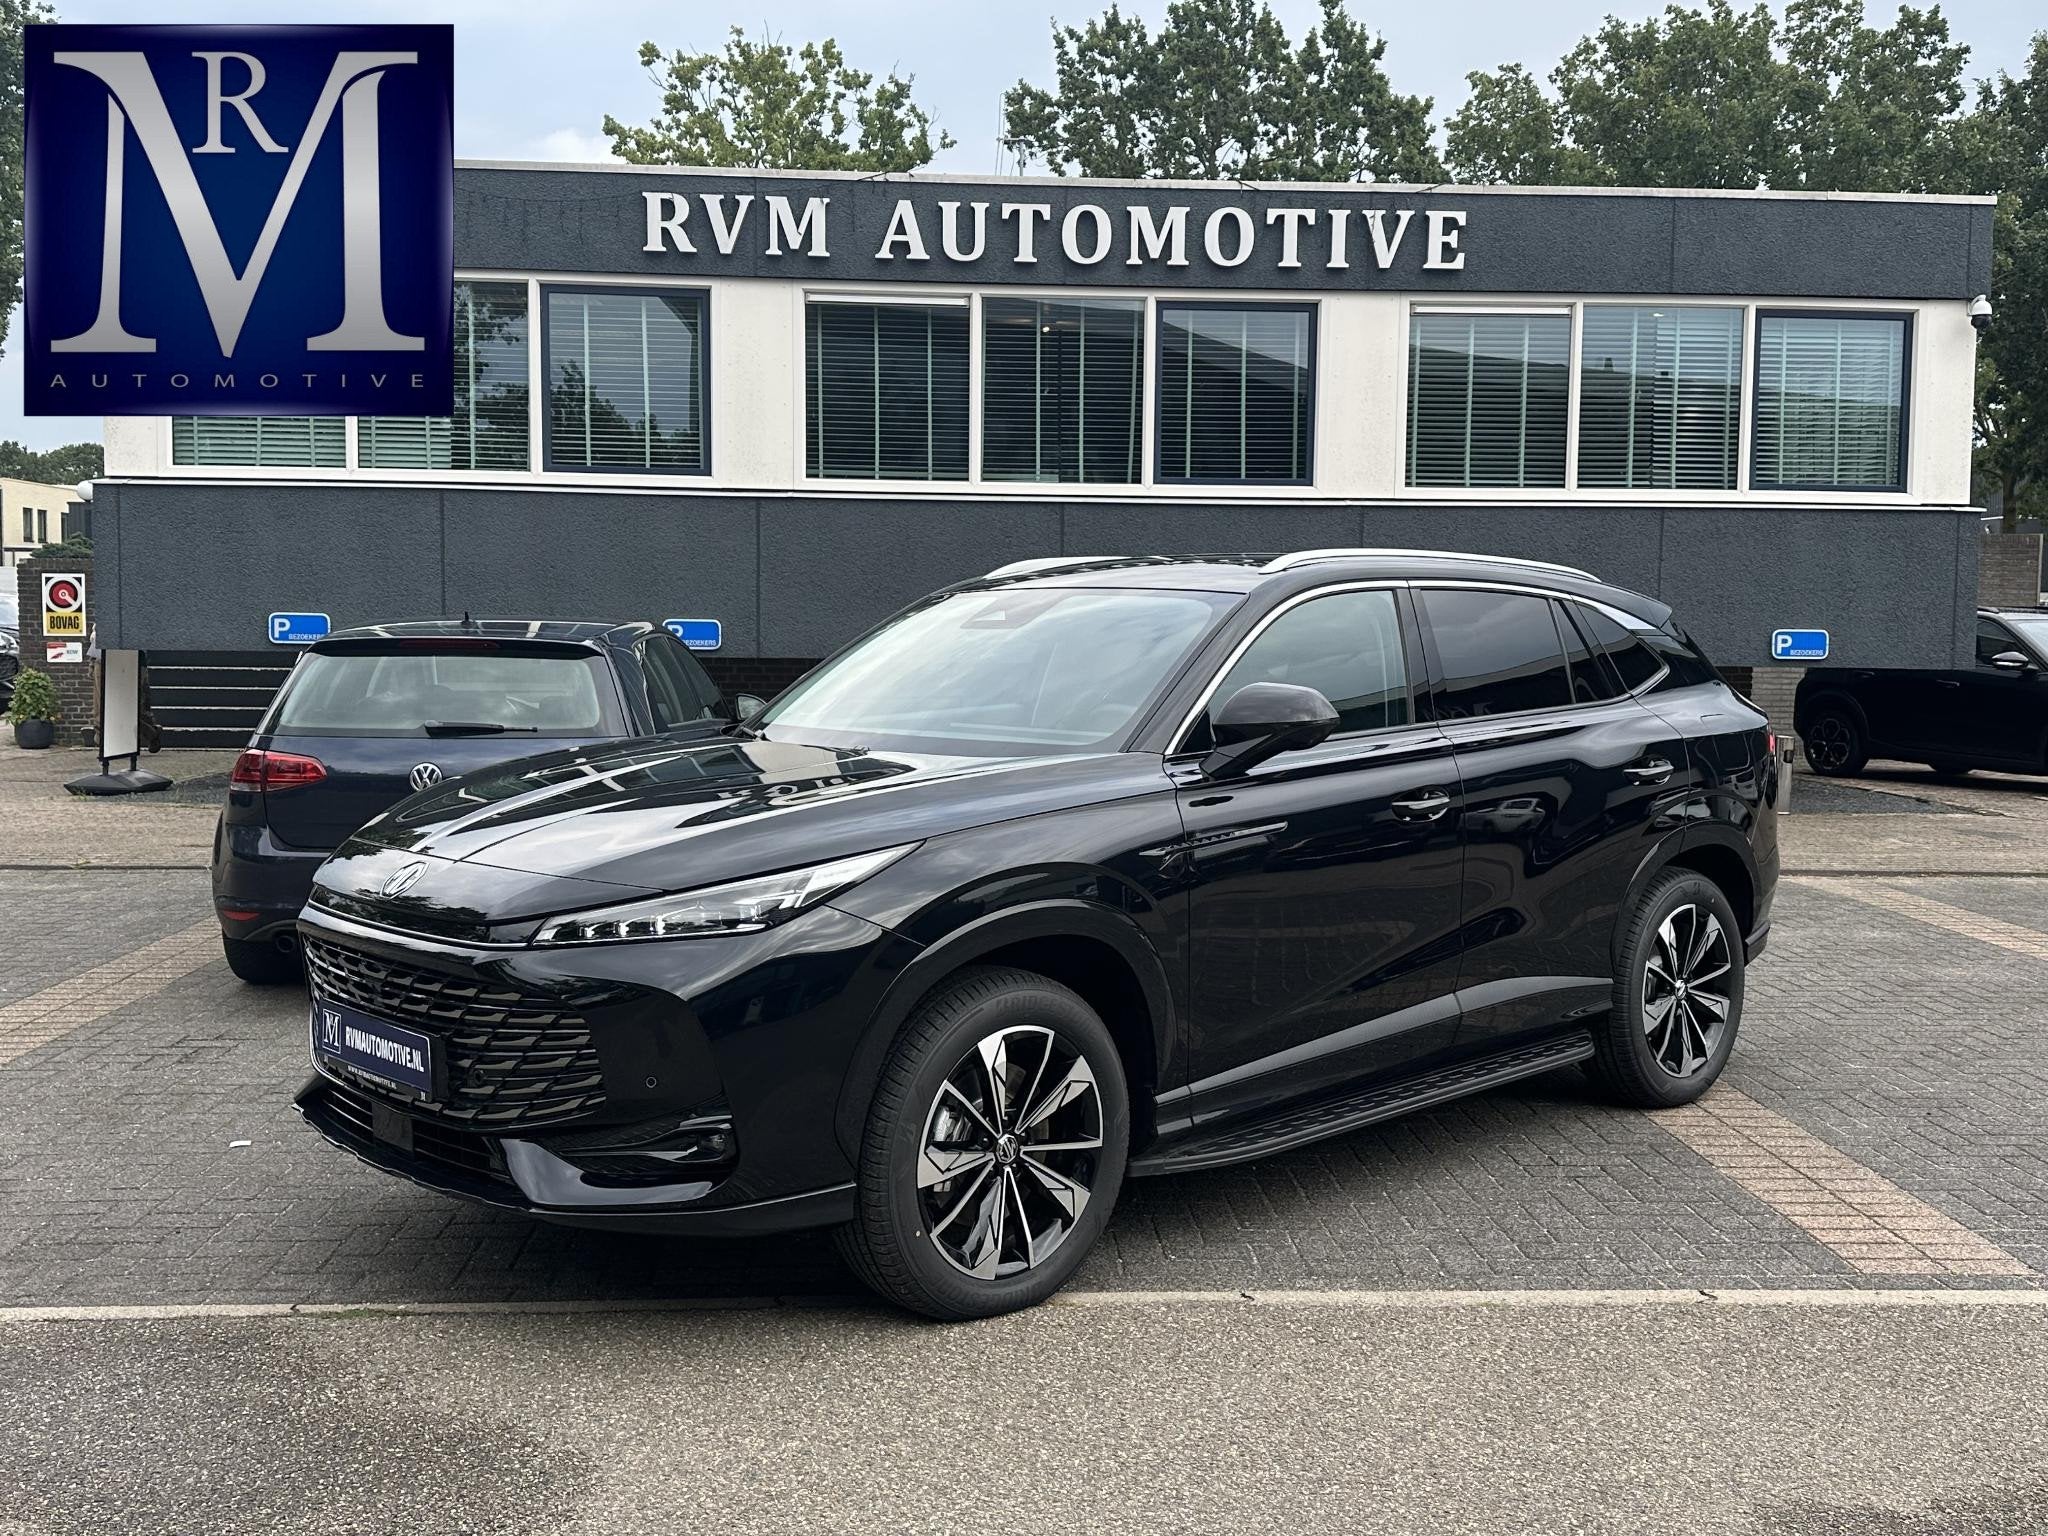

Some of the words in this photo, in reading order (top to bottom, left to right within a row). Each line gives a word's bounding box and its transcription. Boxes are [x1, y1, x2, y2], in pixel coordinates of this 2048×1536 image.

[642, 191, 831, 257] RVM
[874, 199, 1467, 271] AUTOMOTIVE
[49, 615, 80, 630] BOVAG
[273, 617, 291, 639] P
[1776, 634, 1793, 655] P
[345, 1025, 425, 1073] RVMAUTOMOTIVE.NL
